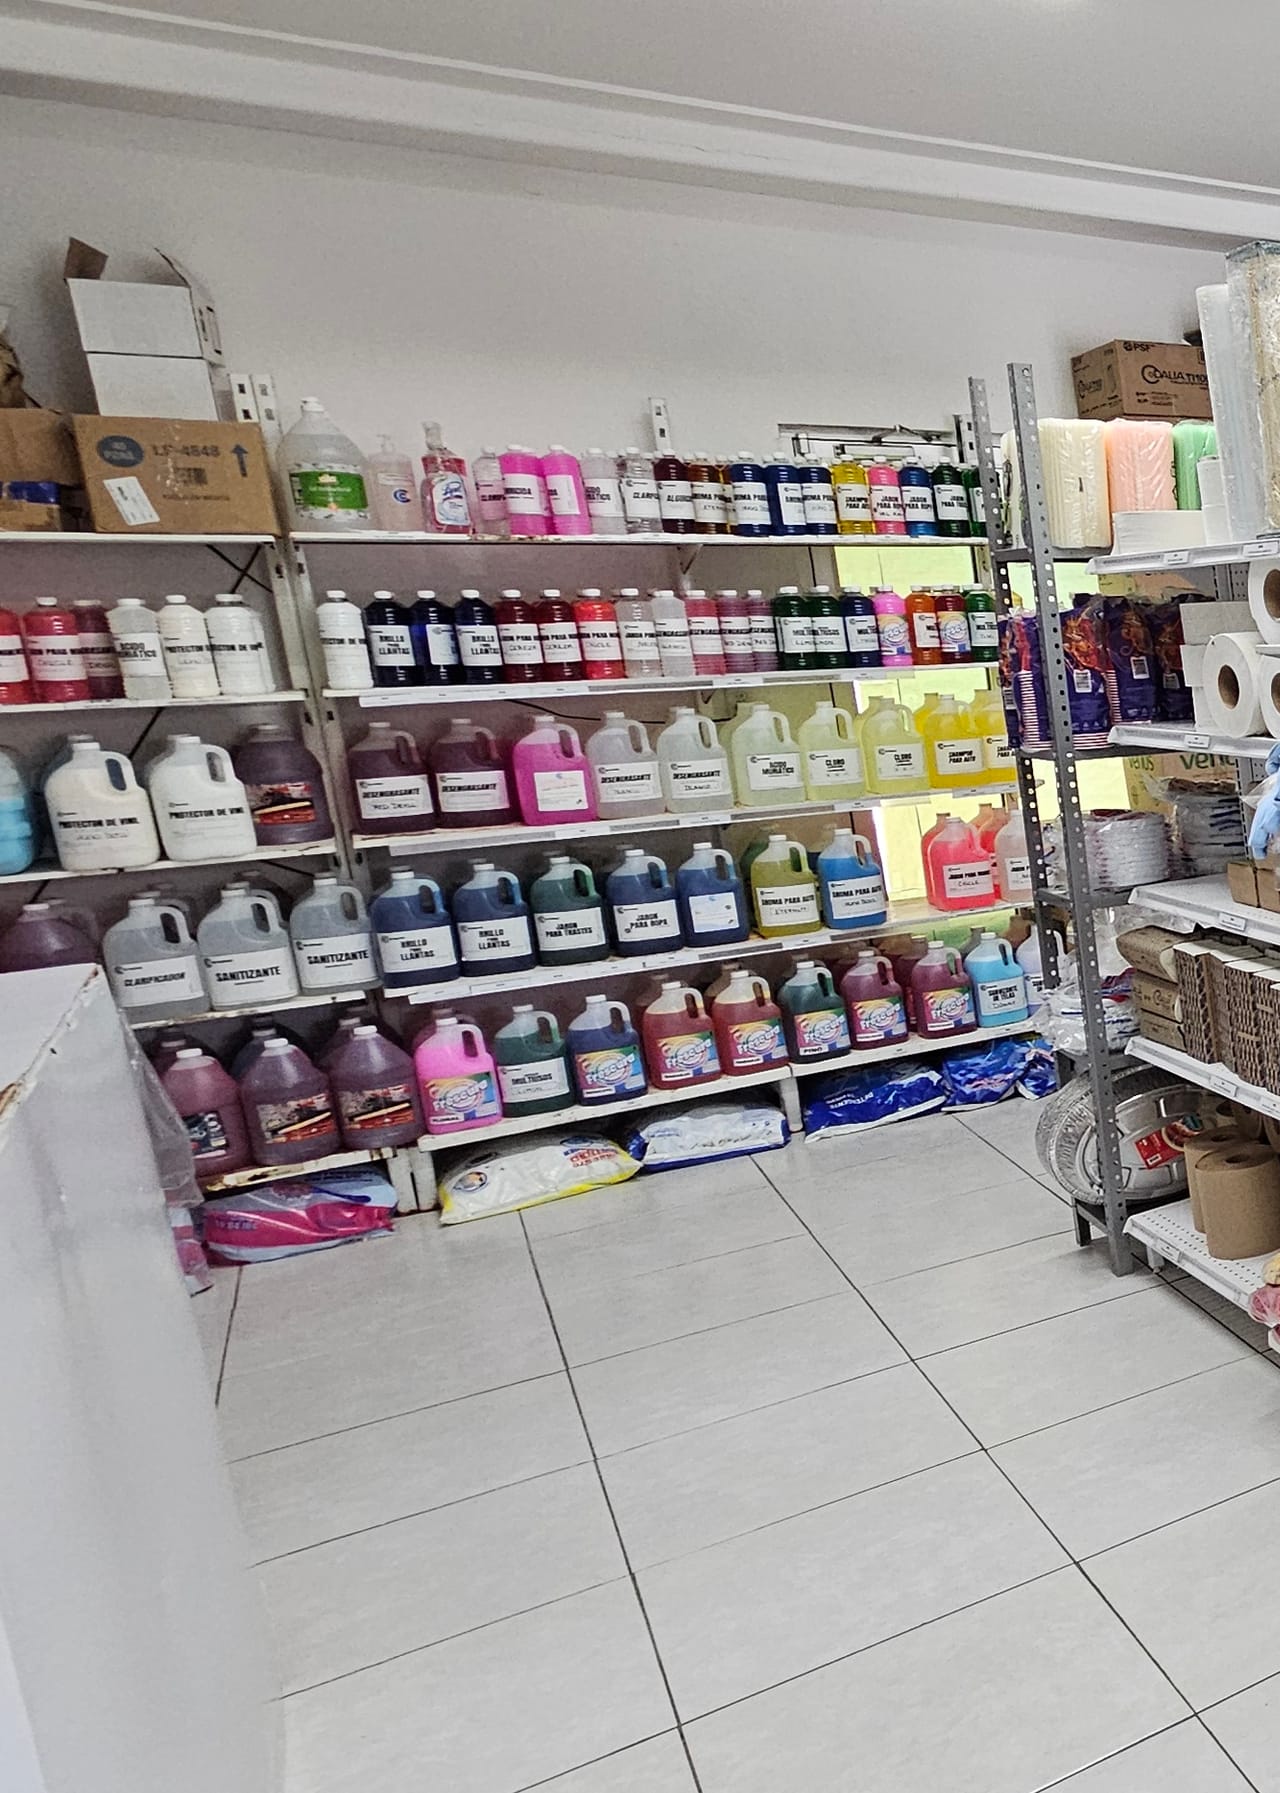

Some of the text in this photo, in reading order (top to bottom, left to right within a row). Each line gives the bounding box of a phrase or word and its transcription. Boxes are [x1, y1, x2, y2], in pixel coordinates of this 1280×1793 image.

[59, 819, 103, 829] PROTECTOR
[106, 818, 117, 827] DE
[170, 808, 229, 820] PROTECTOR DE
[308, 950, 369, 966] SANITIZANTE
[215, 966, 281, 982] SANITIZANTE
[736, 1026, 780, 1056] Frescura
[804, 1013, 845, 1044] Frescura
[665, 1038, 711, 1069] Frescura
[586, 1053, 636, 1085] Frescura
[433, 1080, 488, 1111] Frescura
